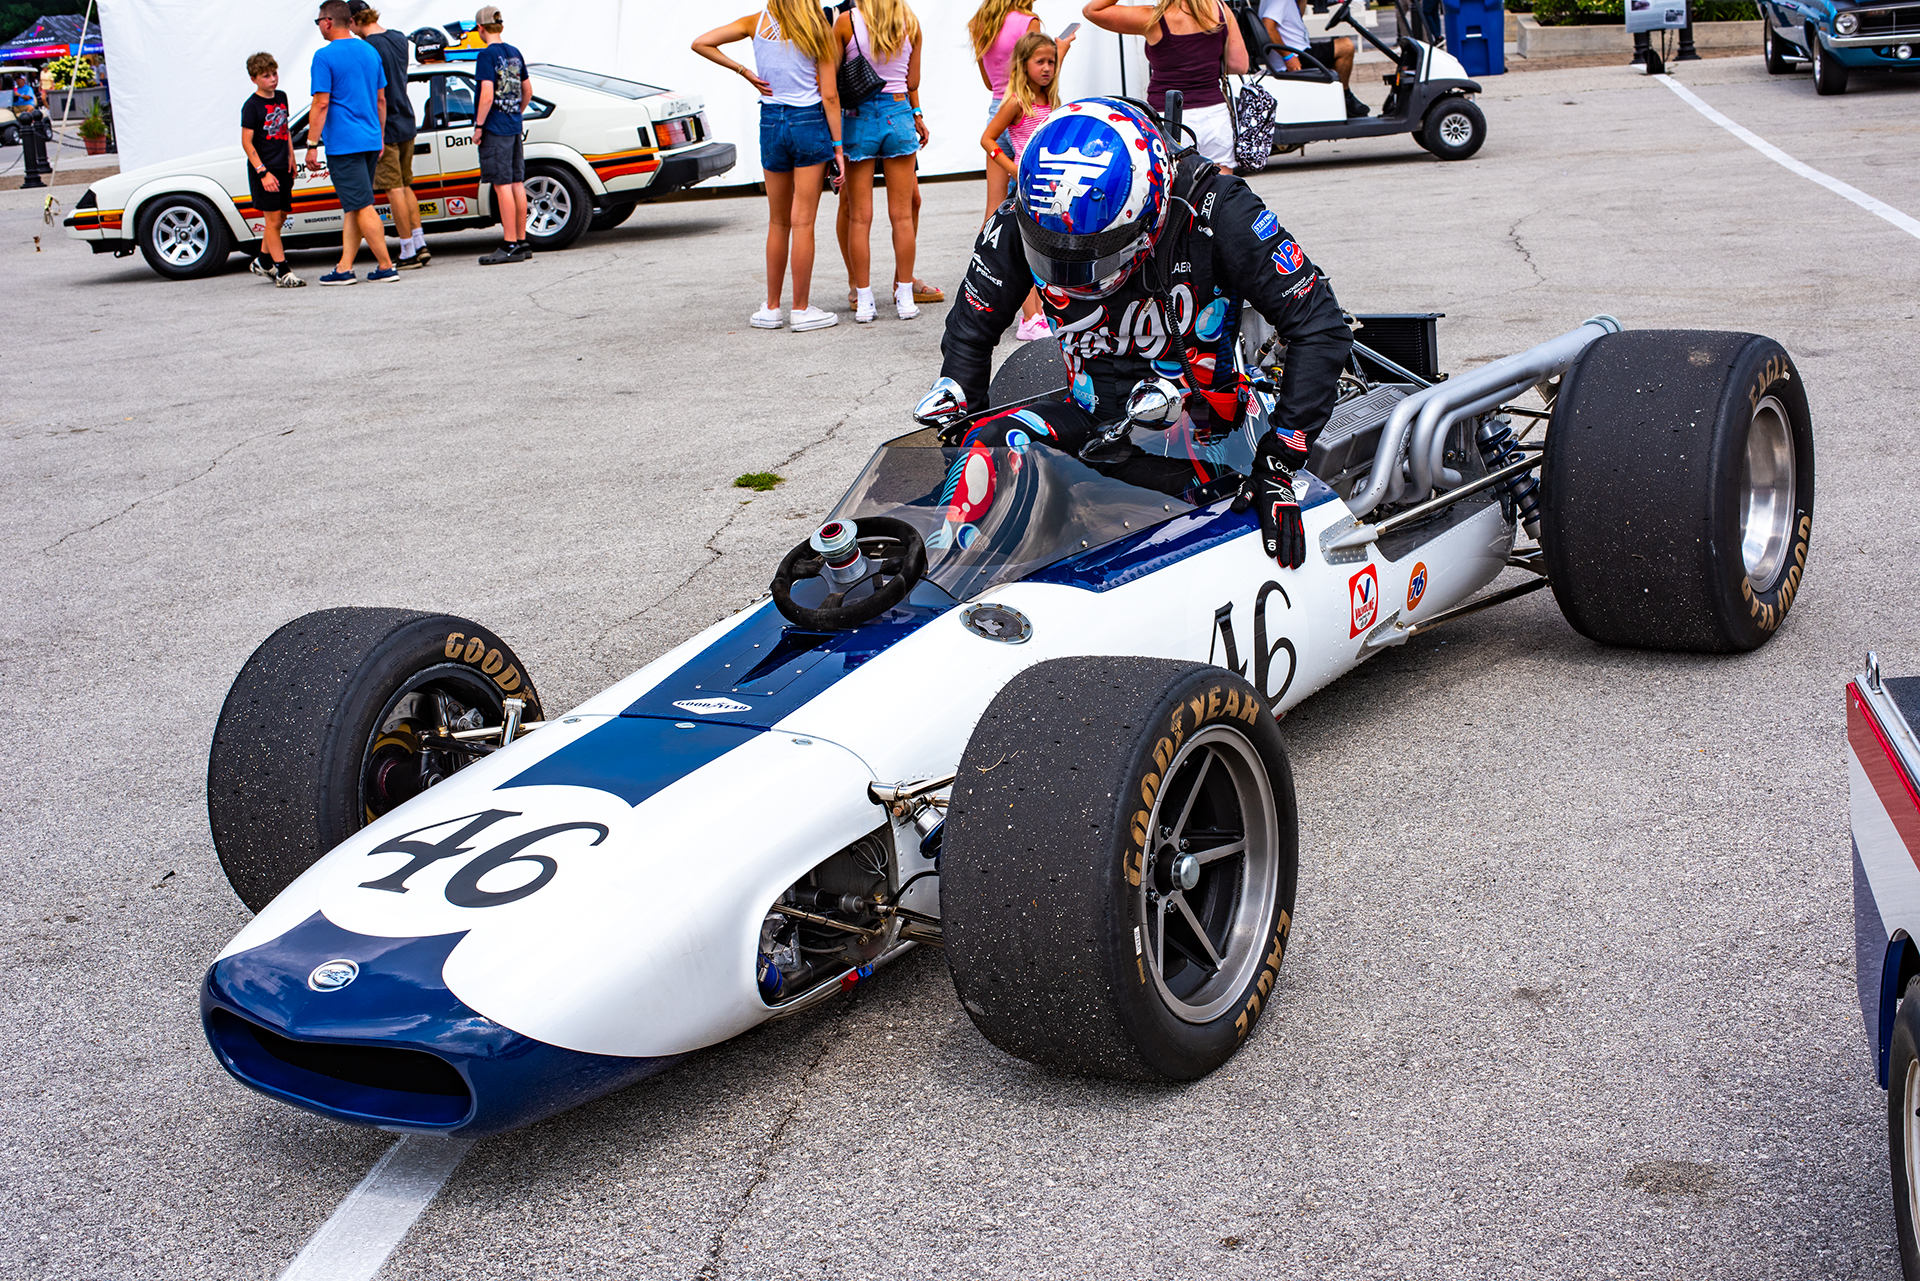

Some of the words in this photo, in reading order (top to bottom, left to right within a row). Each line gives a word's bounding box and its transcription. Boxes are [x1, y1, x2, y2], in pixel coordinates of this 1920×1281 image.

[445, 135, 473, 148] Dan
[1271, 239, 1295, 274] VP
[1749, 354, 1790, 411] EAGLE
[1408, 568, 1426, 603] 76
[1208, 580, 1298, 711] 46
[357, 808, 610, 909] 46
[1235, 908, 1293, 1040] EAGLE
